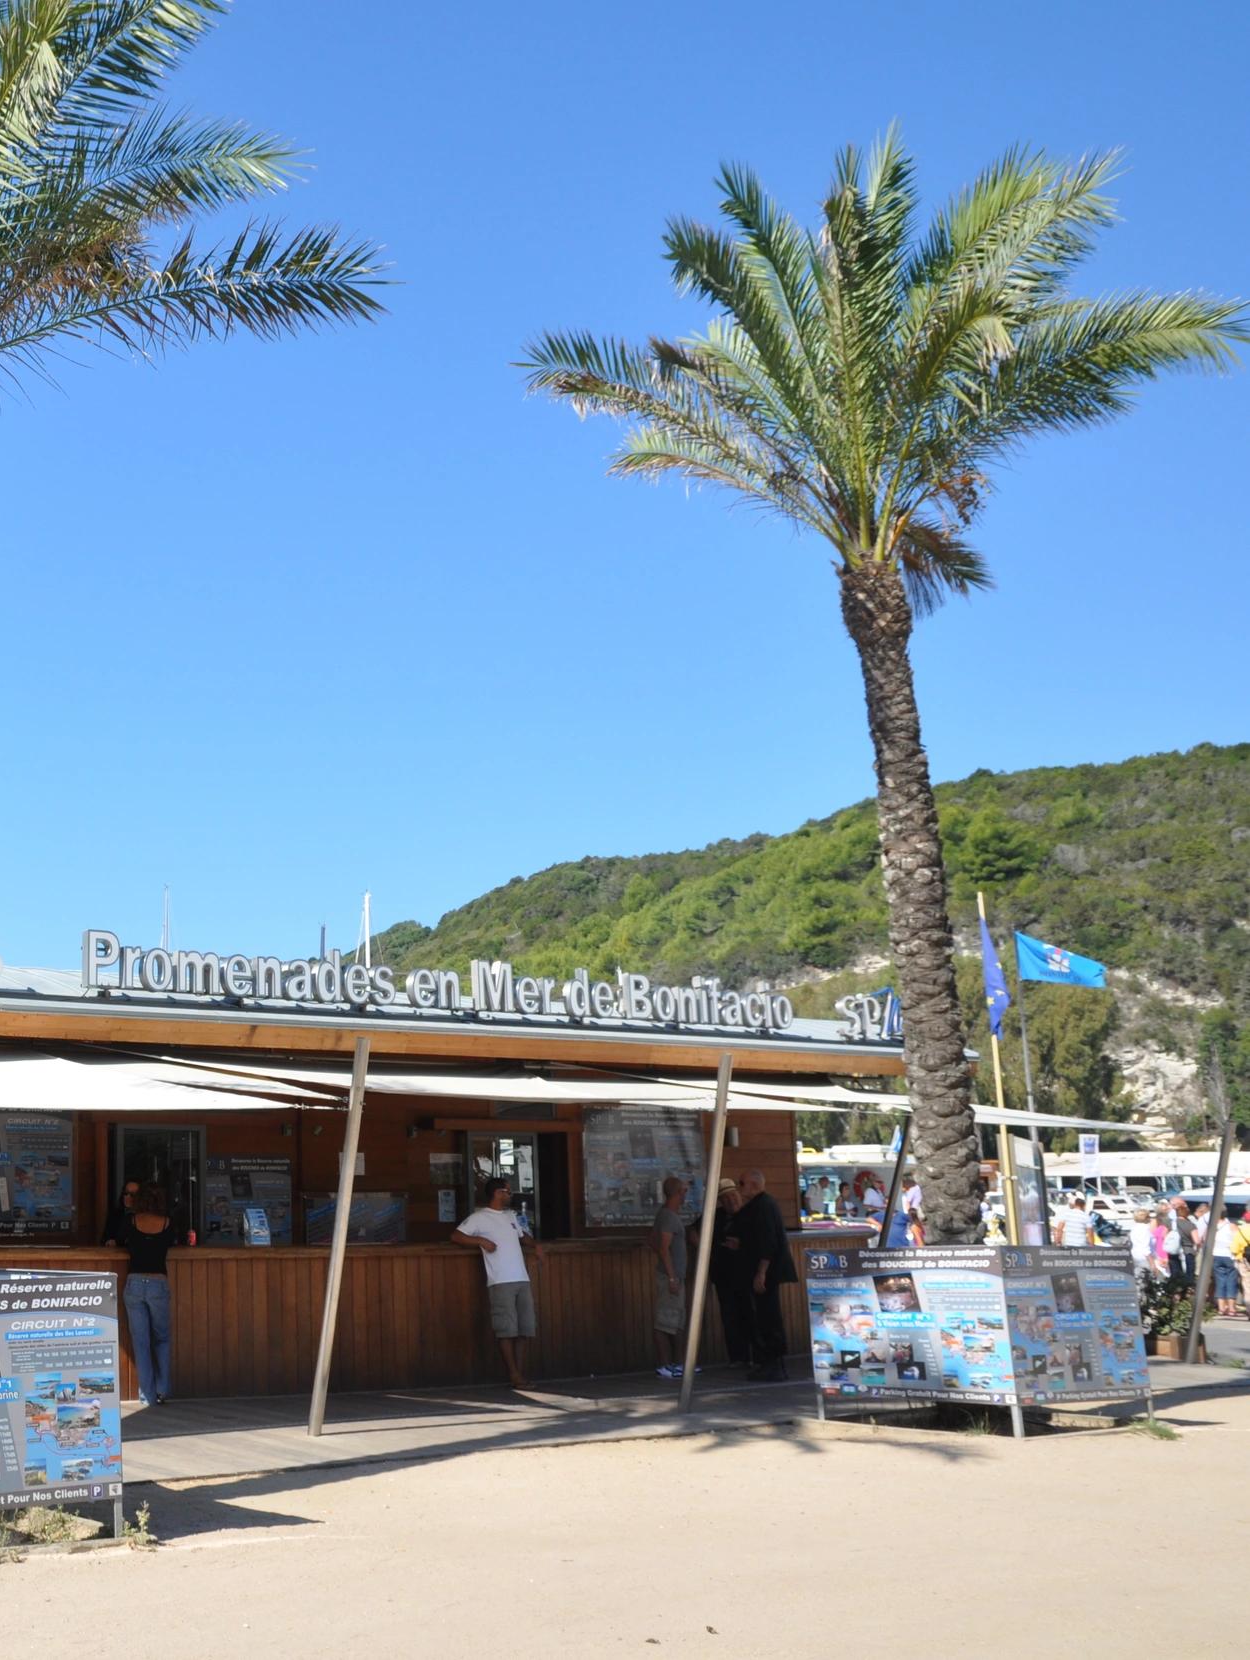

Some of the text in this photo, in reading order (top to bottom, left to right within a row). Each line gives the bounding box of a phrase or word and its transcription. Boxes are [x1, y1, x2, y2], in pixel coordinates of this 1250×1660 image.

[82, 929, 794, 1030] Promenades en Mer de Bonifacio
[861, 1259, 990, 1269] des BOUCHES de BONIFACIO
[0, 1283, 53, 1295] Réserve
[55, 1279, 112, 1292] naturelle
[11, 1299, 28, 1310] de
[31, 1296, 103, 1309] BONIFACIO
[11, 1317, 96, 1330] CIRCUIT N°2
[880, 1389, 906, 1398] Parking
[907, 1390, 932, 1398] Gratuit
[932, 1391, 949, 1399] Pour
[950, 1392, 964, 1400] Nos
[965, 1392, 991, 1401] Clients
[7, 1494, 31, 1505] Pour
[33, 1491, 52, 1501] Nos
[54, 1487, 89, 1499] Clients
[93, 1486, 101, 1496] P
